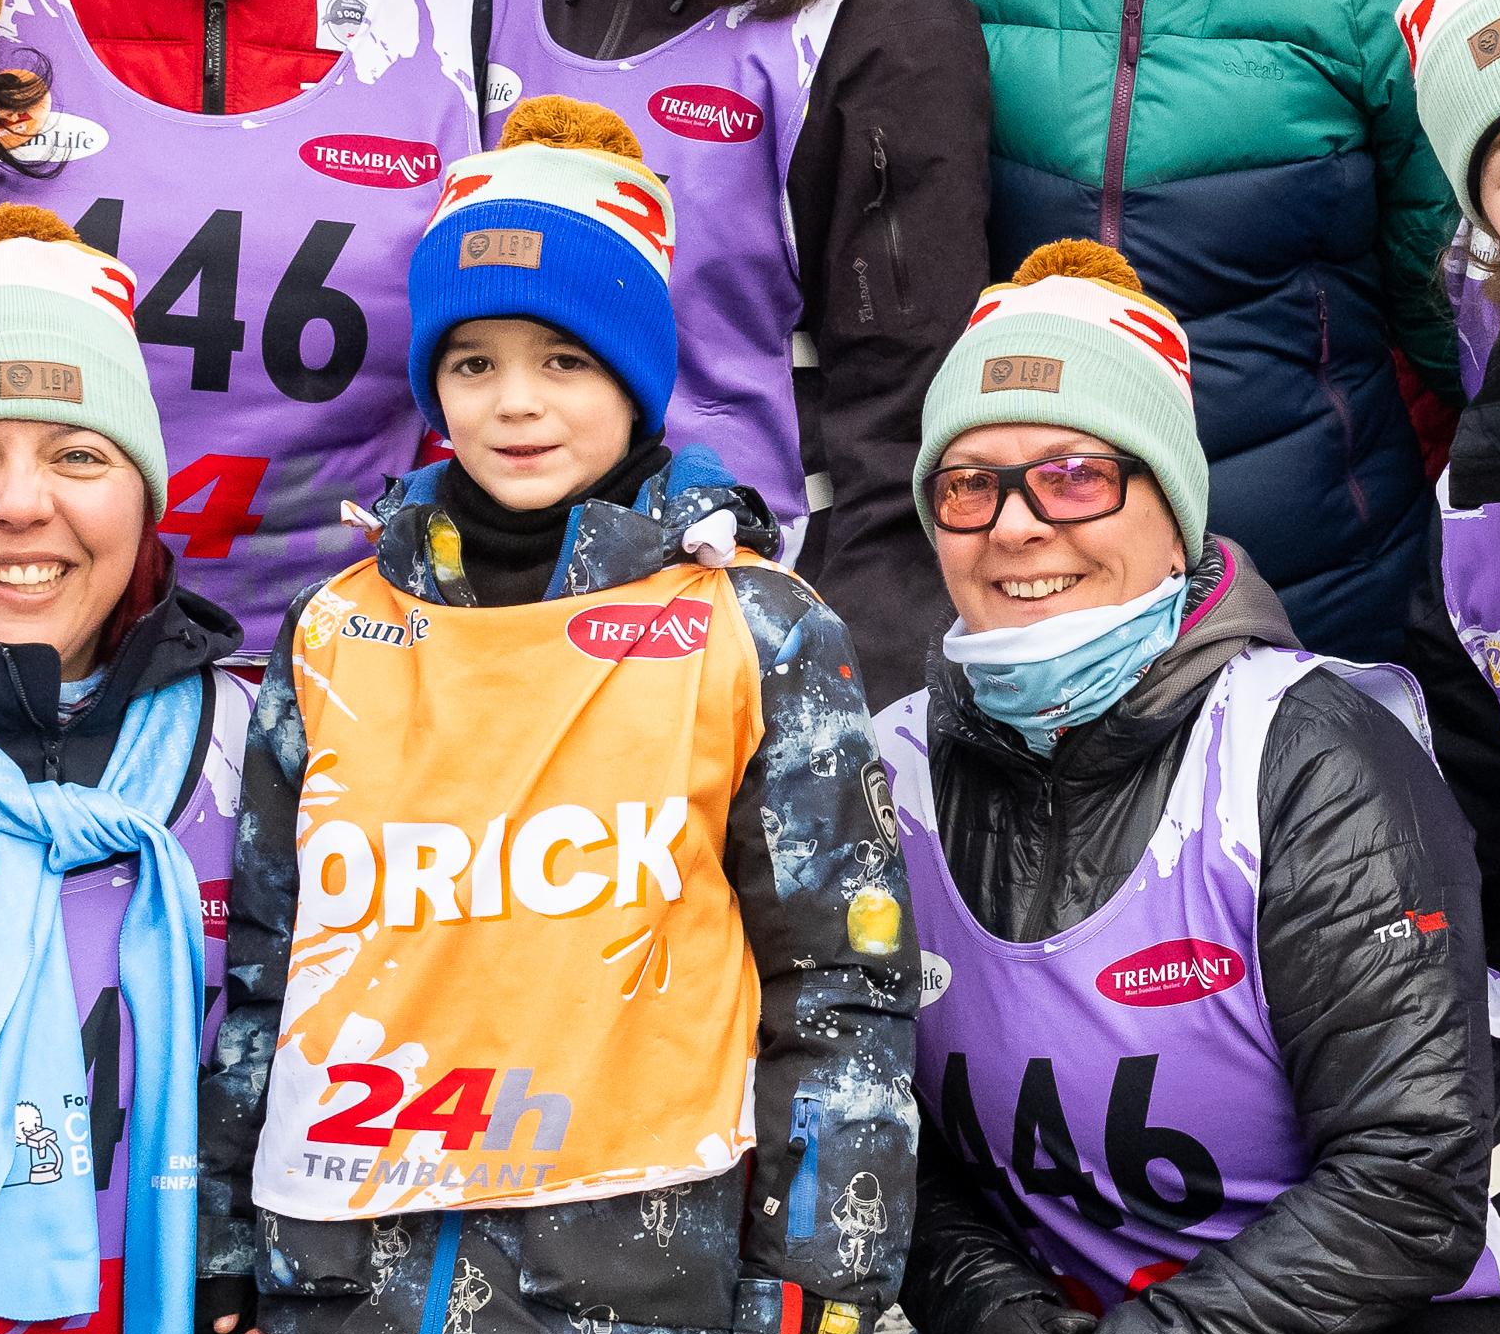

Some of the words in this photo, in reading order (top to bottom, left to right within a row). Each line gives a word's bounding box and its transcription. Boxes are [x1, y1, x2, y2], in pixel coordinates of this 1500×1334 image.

[660, 95, 757, 138] TREMBLANT
[314, 145, 438, 183] TREMBLANT
[342, 614, 405, 646] Sun
[1374, 918, 1411, 944] TCJ
[923, 968, 943, 991] ife
[1112, 956, 1232, 990] TREMBLANT
[307, 1063, 572, 1152] 24h
[303, 1154, 556, 1191] TREMBLANT
